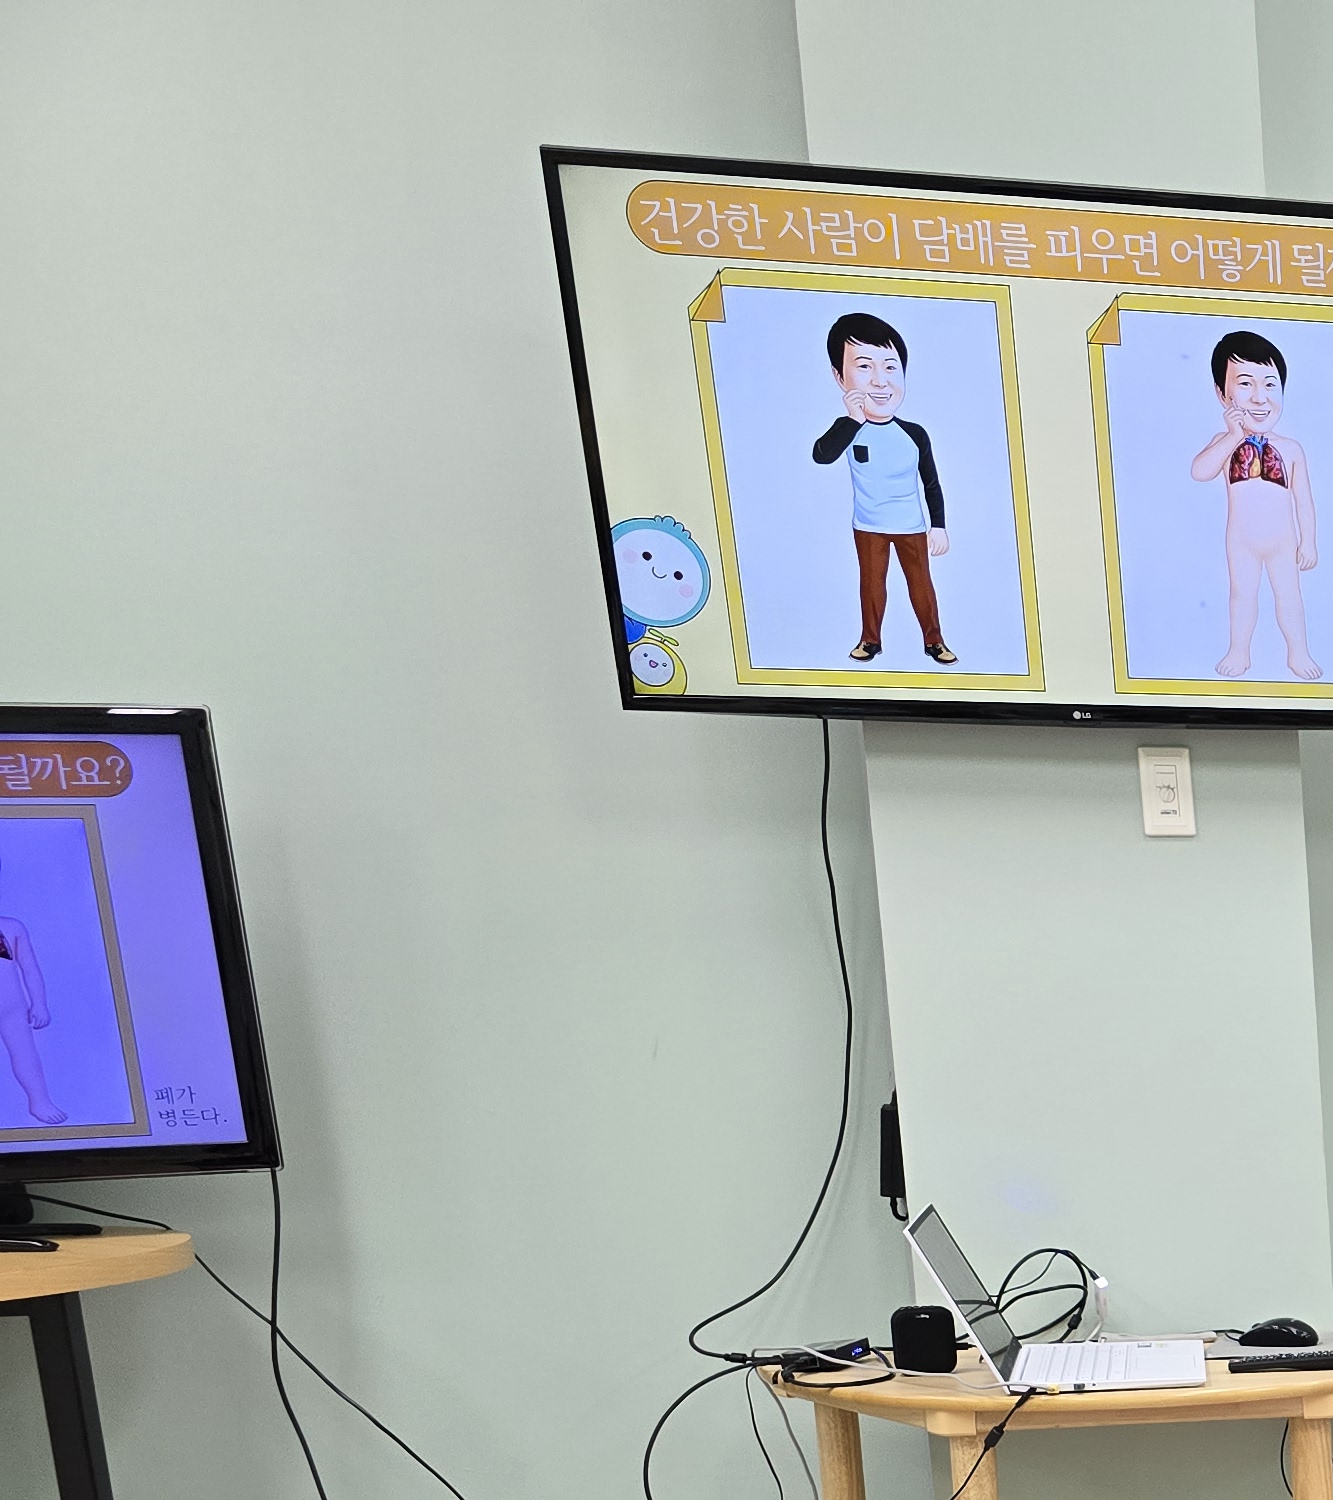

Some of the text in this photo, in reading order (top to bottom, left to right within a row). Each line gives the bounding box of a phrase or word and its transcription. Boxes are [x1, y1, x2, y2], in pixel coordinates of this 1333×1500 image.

[640, 197, 768, 250] 건강한
[778, 206, 901, 260] 사람이
[912, 215, 1036, 270] 담배를
[1045, 225, 1161, 276] 피우면
[1171, 234, 1282, 285] 어떻게
[154, 1085, 197, 1105] 폐가
[158, 1107, 227, 1127] 병든다.
